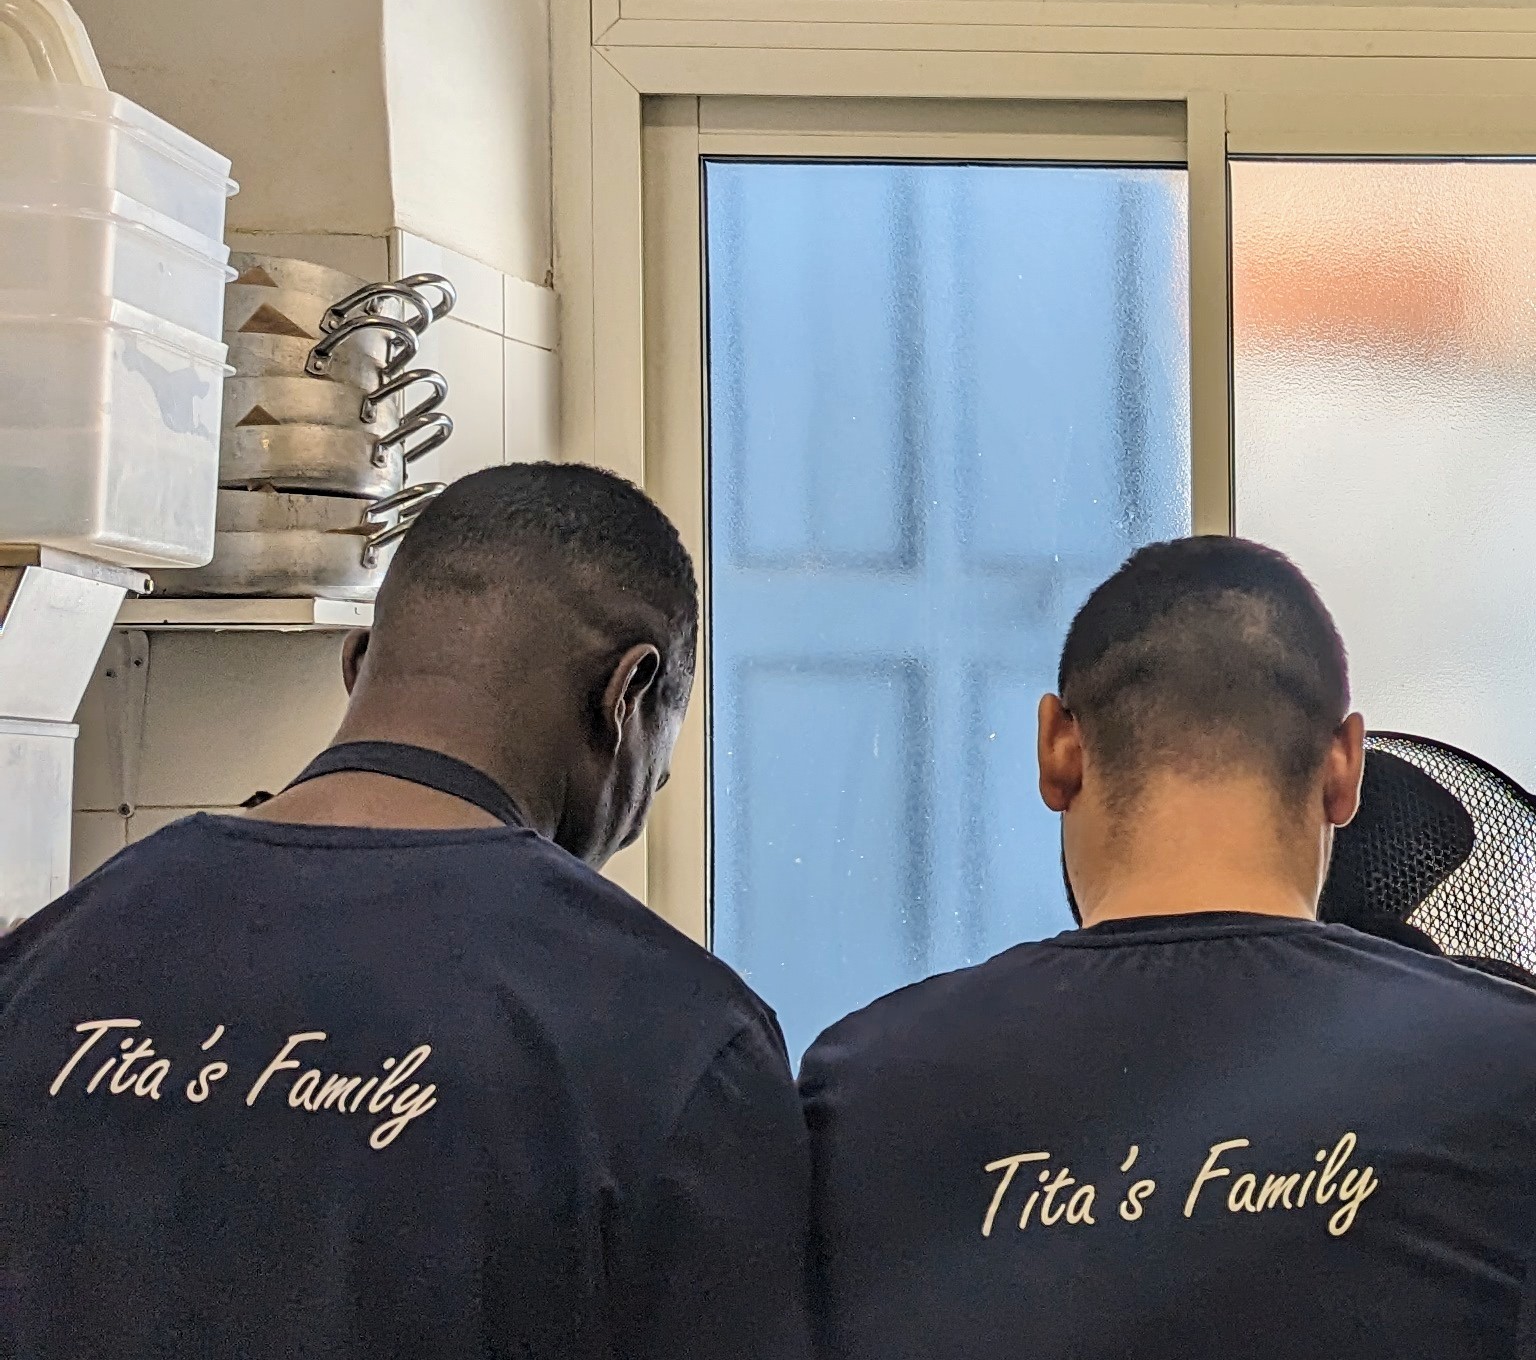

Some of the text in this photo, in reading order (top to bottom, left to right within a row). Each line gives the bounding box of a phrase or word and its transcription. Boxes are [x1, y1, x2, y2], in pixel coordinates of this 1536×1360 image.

[49, 1018, 437, 1150] Tita's Family
[981, 1132, 1379, 1237] Tita's Family
